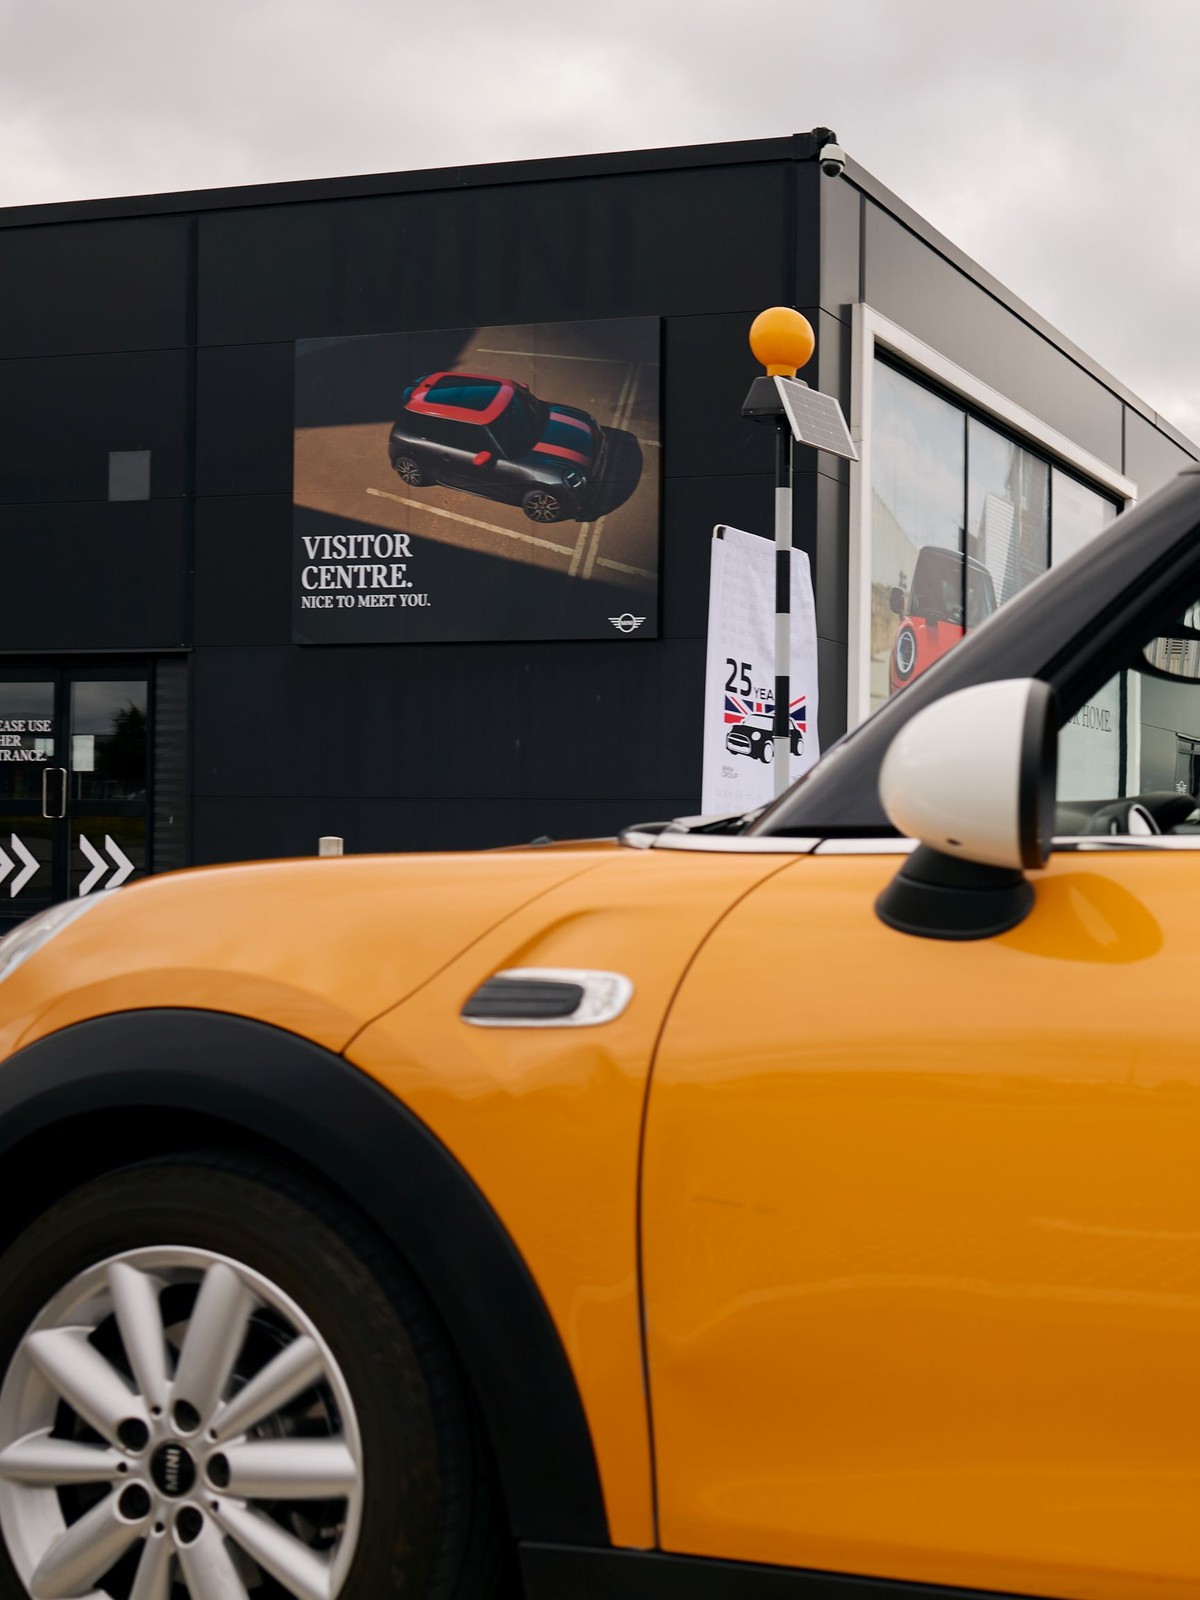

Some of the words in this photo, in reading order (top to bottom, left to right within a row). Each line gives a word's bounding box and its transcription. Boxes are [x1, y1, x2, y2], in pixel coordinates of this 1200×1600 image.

[301, 533, 413, 560] VISITOR
[301, 564, 413, 590] CENTRE.
[301, 595, 334, 609] NICE
[336, 595, 356, 608] TO
[357, 594, 397, 608] MEET
[399, 593, 432, 607] YOU.
[725, 657, 752, 697] 25
[754, 687, 775, 701] YEA
[28, 720, 52, 732] USE
[1082, 704, 1112, 733] HOME.
[166, 1448, 180, 1491] MINI
